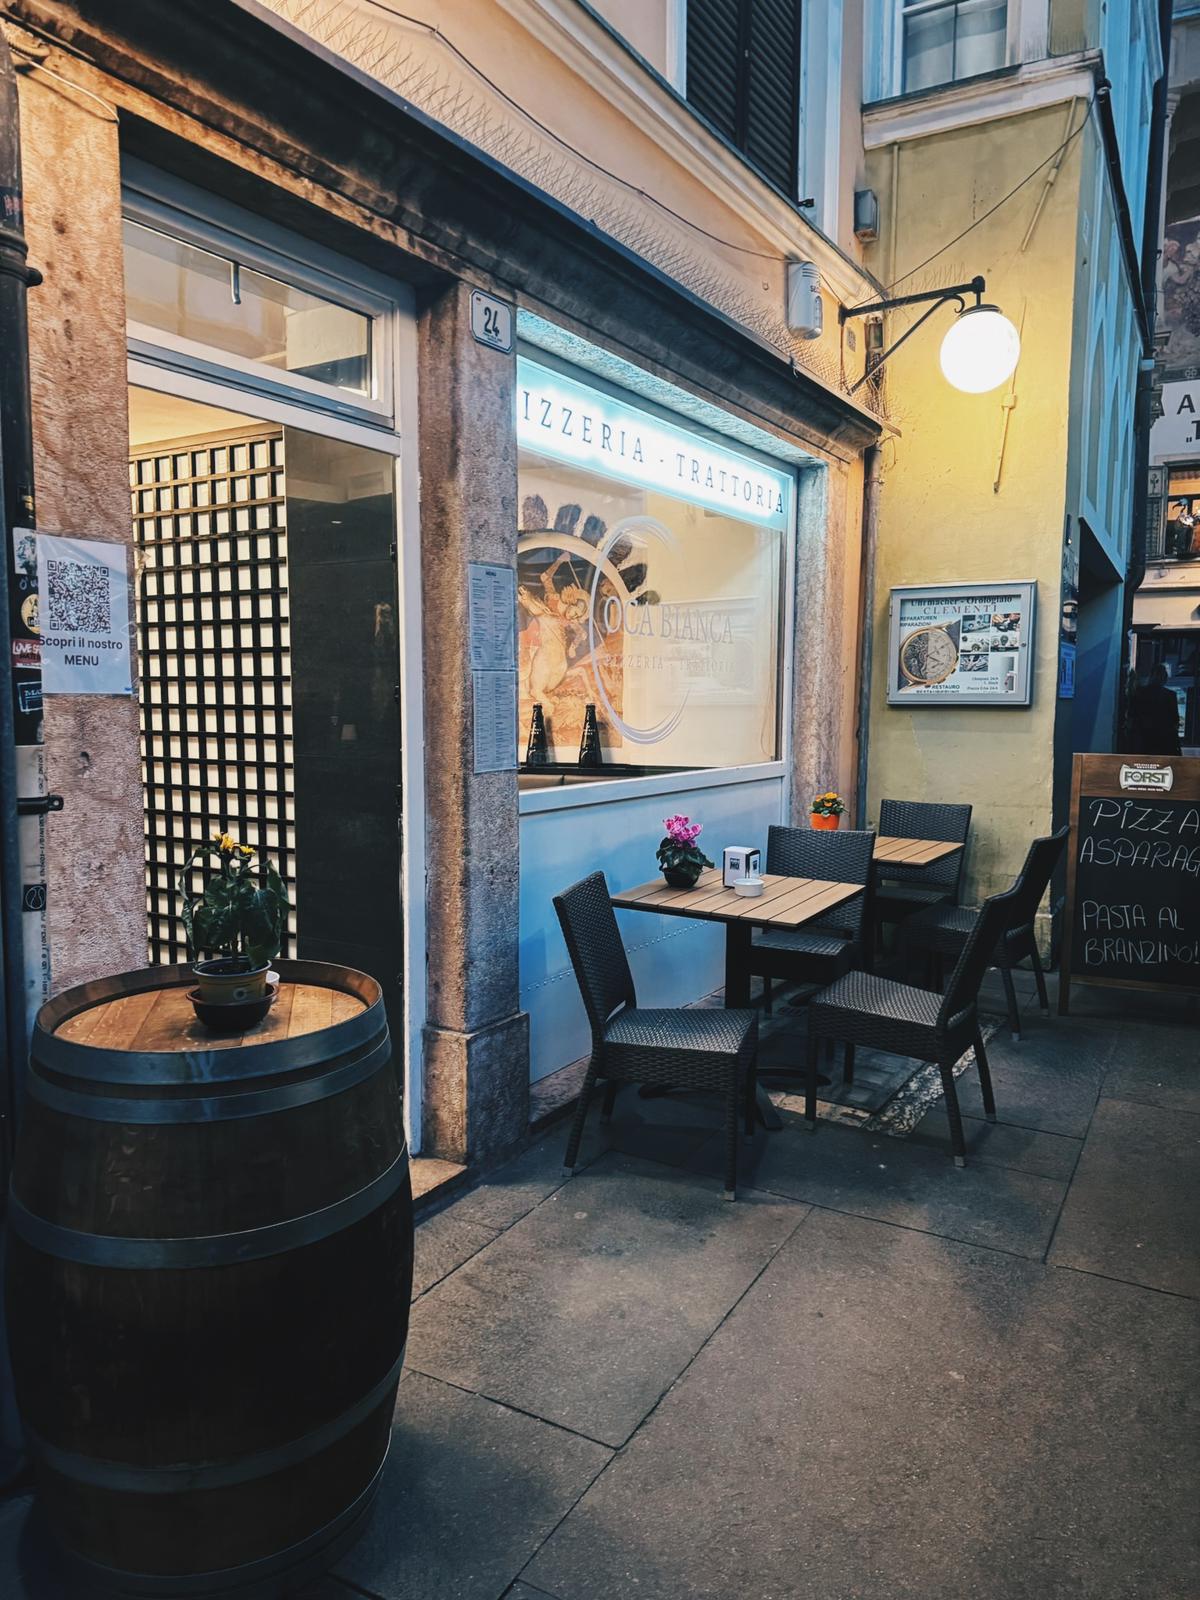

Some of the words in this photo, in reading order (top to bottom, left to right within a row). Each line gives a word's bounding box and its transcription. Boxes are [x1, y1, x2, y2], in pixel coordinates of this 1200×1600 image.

[484, 306, 500, 337] 24
[676, 453, 785, 514] TRATTORIA
[923, 604, 997, 615] CLEMENTI
[660, 604, 734, 644] BIANCA
[39, 635, 75, 649] Scopri
[78, 637, 85, 648] il
[87, 639, 123, 650] nostro
[64, 655, 99, 666] MENU
[1124, 771, 1169, 783] FORST
[1082, 900, 1146, 931] PASTA
[1158, 906, 1185, 931] AL
